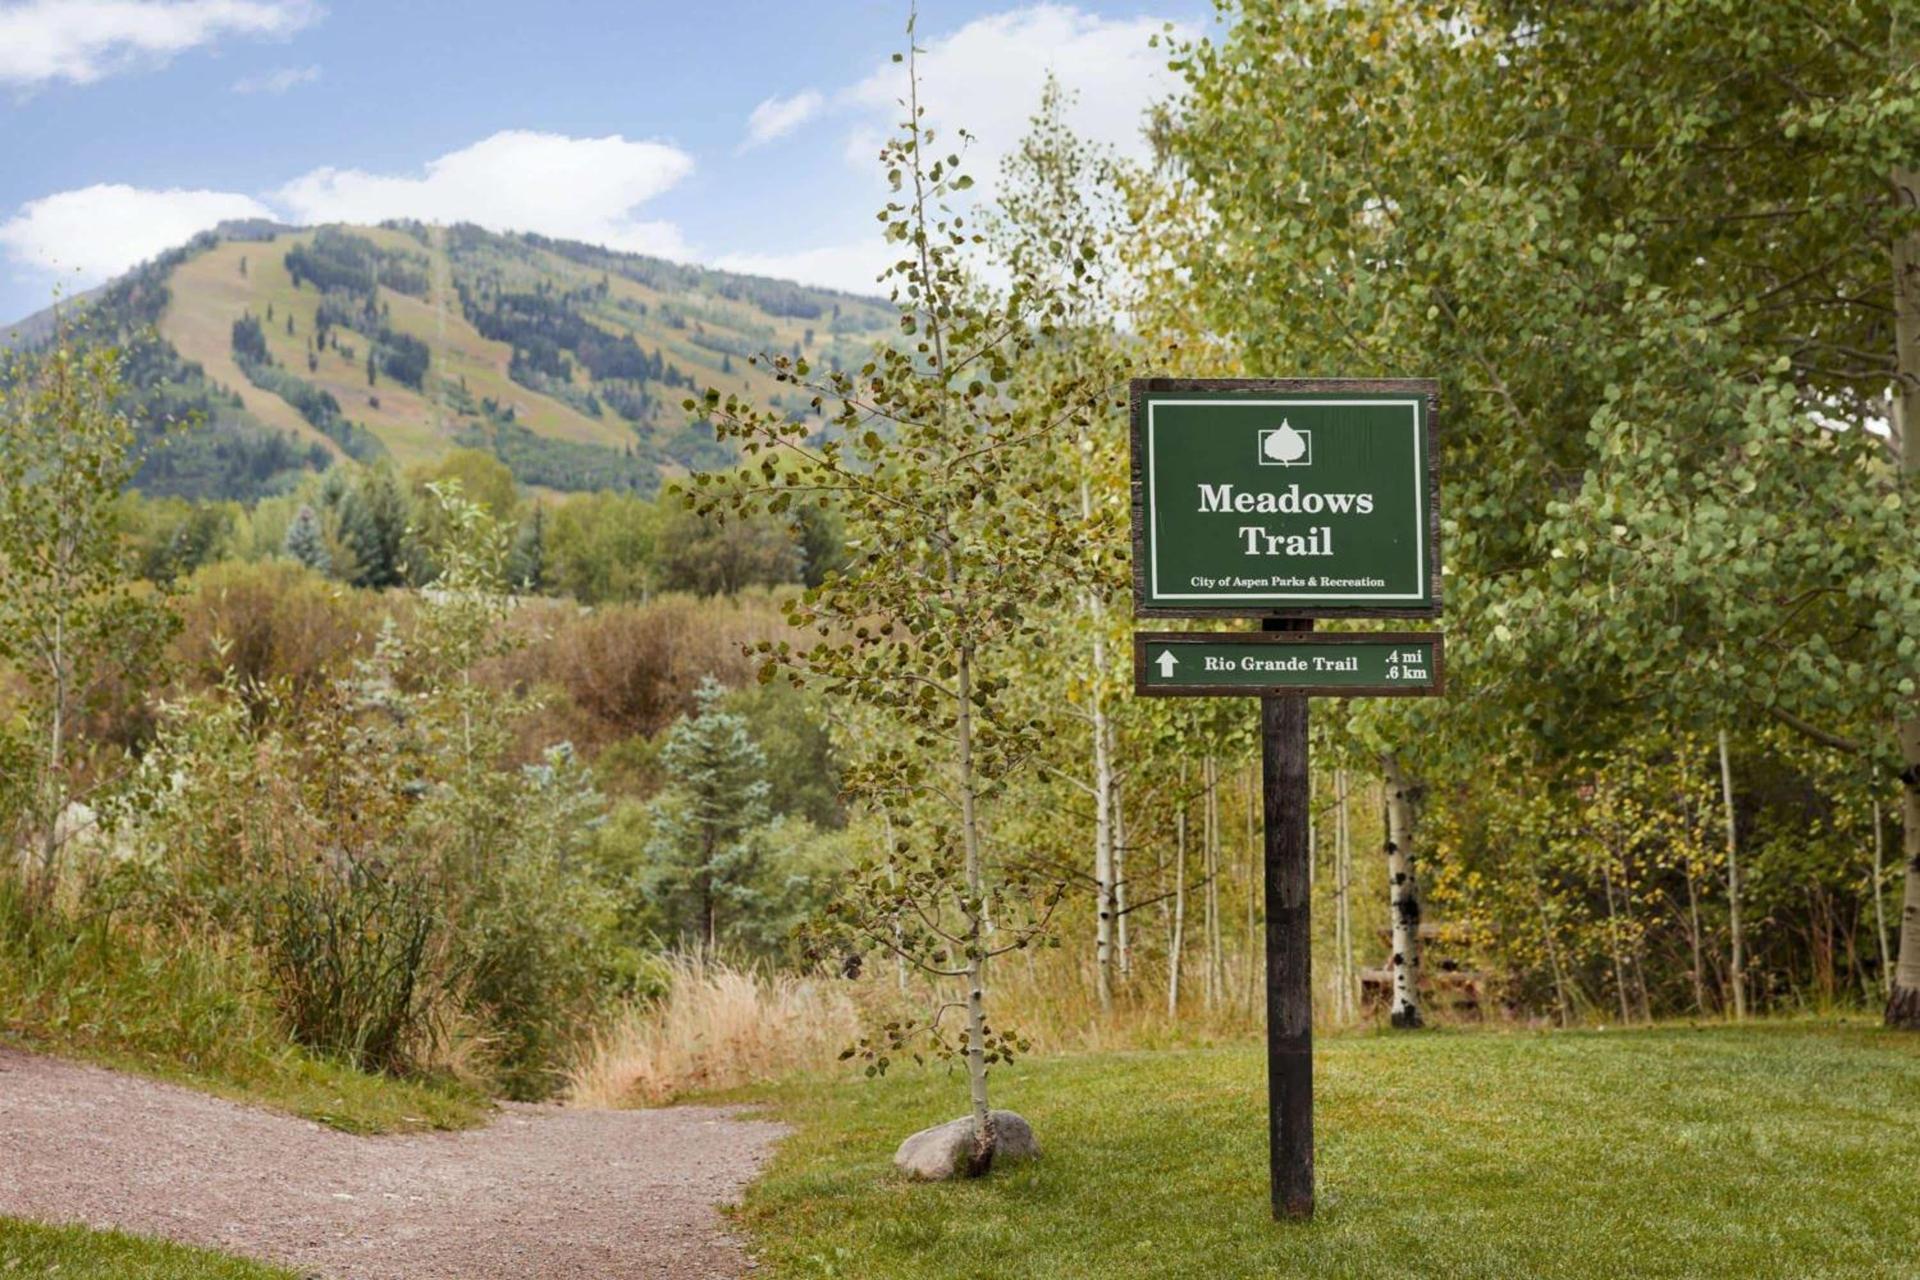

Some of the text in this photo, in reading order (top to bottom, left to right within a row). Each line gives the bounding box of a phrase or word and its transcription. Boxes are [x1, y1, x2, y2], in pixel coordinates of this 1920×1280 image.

[1197, 483, 1374, 514] Meadows
[1238, 526, 1334, 556] Trail
[1190, 576, 1386, 588] City of Aspen Parks & Recreation
[1204, 656, 1359, 671] Rio Grande Trail
[1385, 650, 1423, 664] .4 mi
[1385, 665, 1428, 680] .6 km
